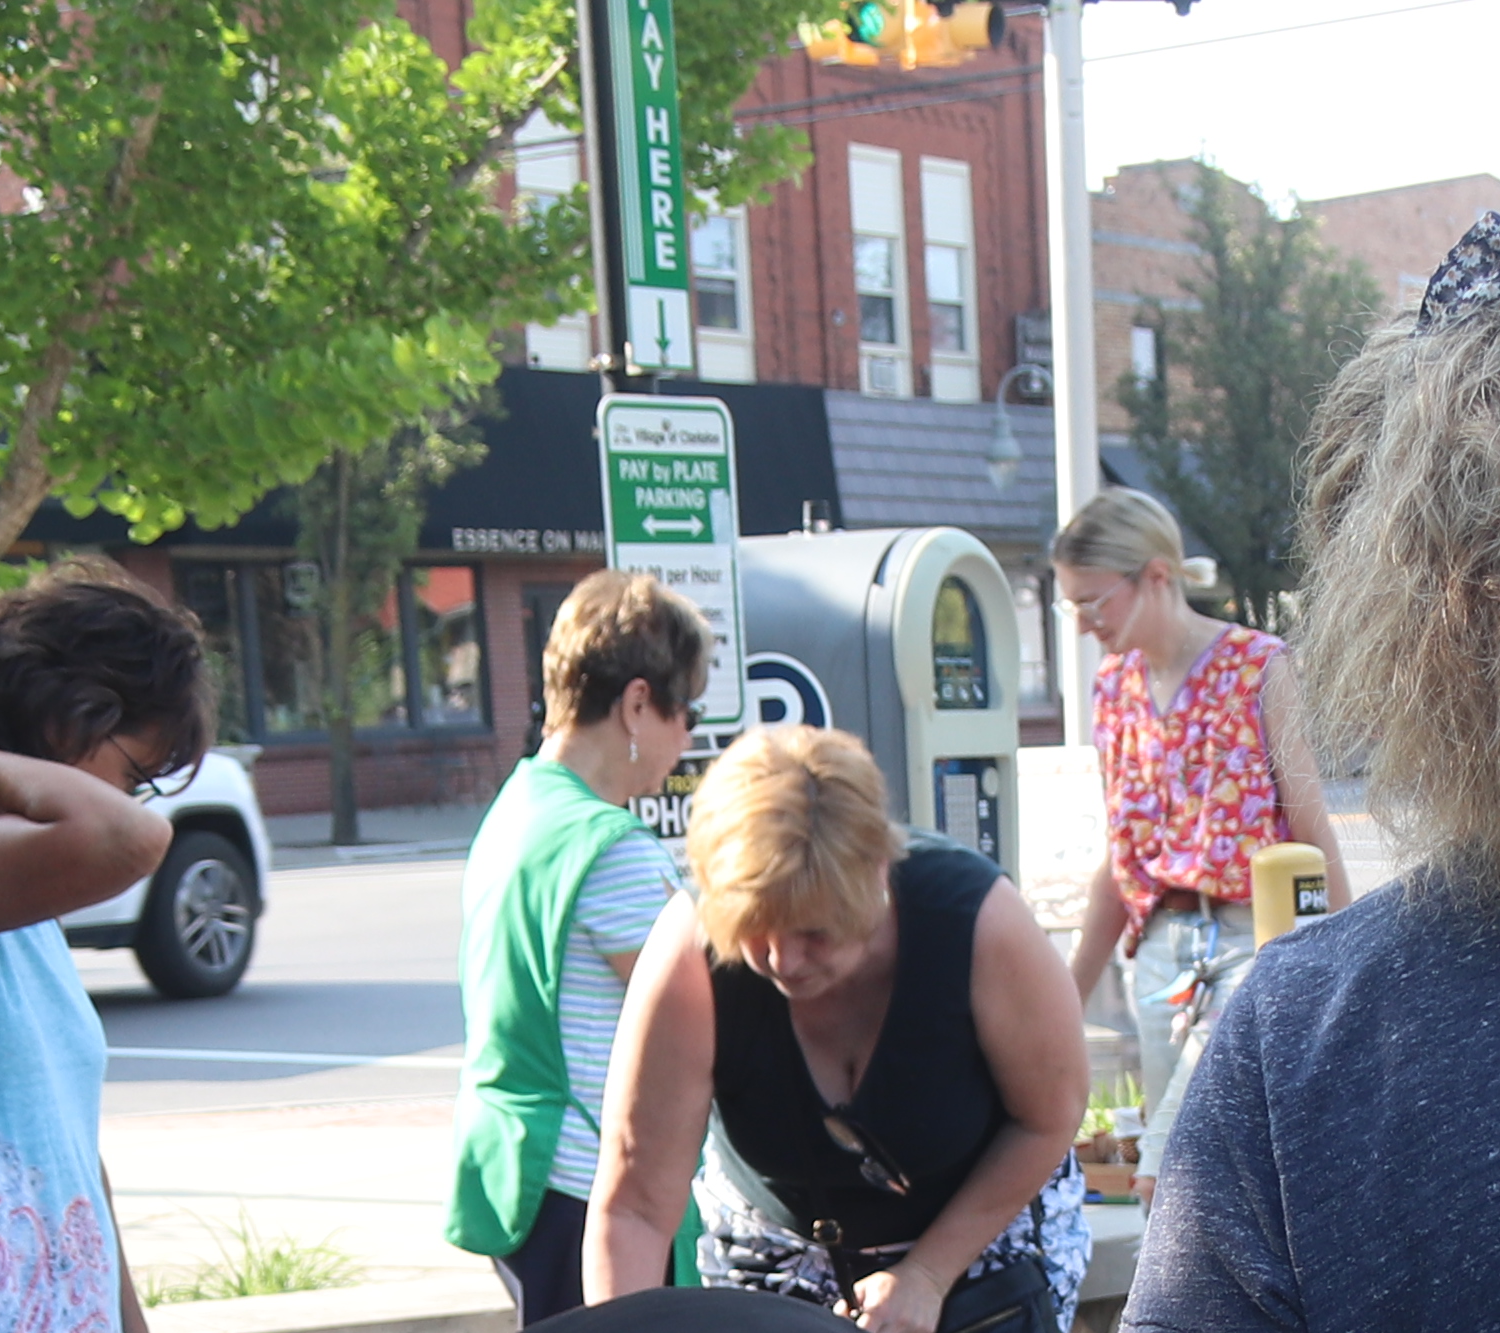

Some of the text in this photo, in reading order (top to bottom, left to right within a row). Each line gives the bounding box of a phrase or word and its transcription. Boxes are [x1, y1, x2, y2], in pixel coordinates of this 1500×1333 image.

[645, 105, 677, 271] HERE
[619, 458, 719, 485] PAY by PLATE
[635, 485, 706, 510] PARKING
[451, 527, 539, 553] ESSENCE
[541, 528, 572, 553] ON
[667, 568, 687, 585] per
[690, 563, 722, 584] Hour
